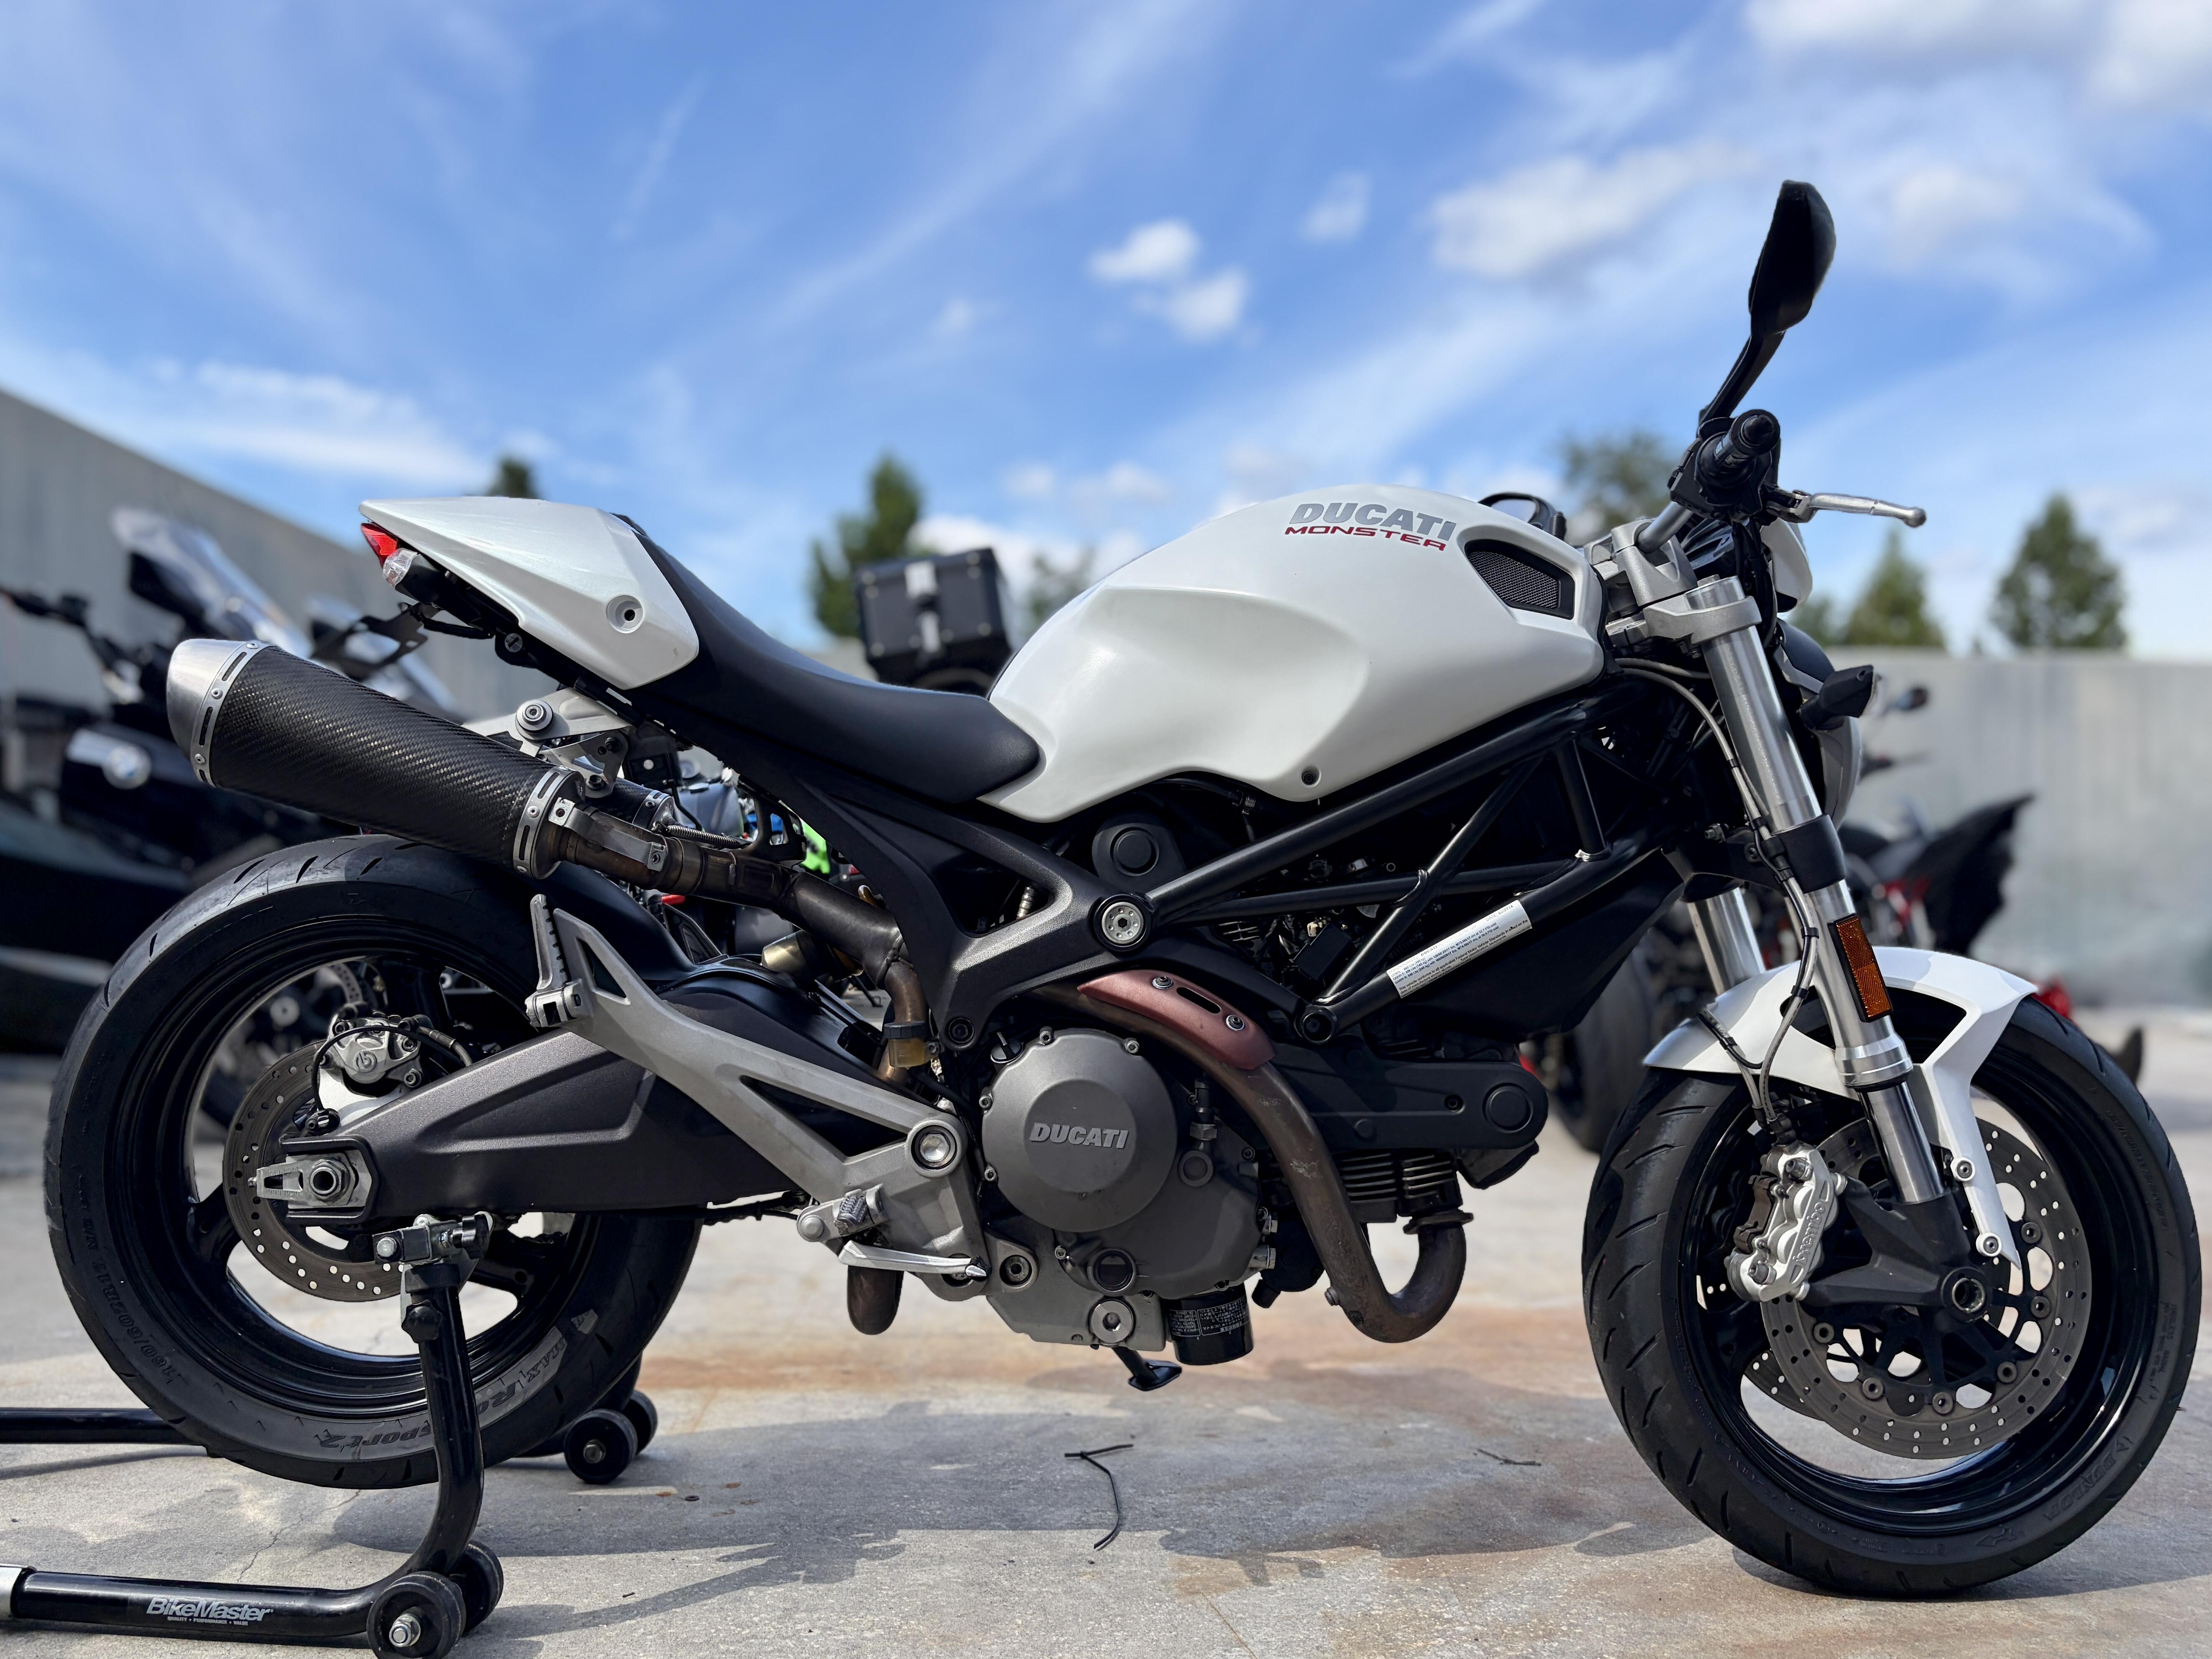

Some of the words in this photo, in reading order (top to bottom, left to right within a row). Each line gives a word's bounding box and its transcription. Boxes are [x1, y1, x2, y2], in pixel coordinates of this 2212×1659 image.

[1289, 503, 1457, 541] DUCATI
[1285, 526, 1446, 551] MONSTER
[1029, 1122, 1128, 1149] DUCATI
[1793, 1202, 1825, 1264] brembo
[2046, 1452, 2117, 1521] DUNLOP
[146, 1597, 271, 1621] BikeMaster
